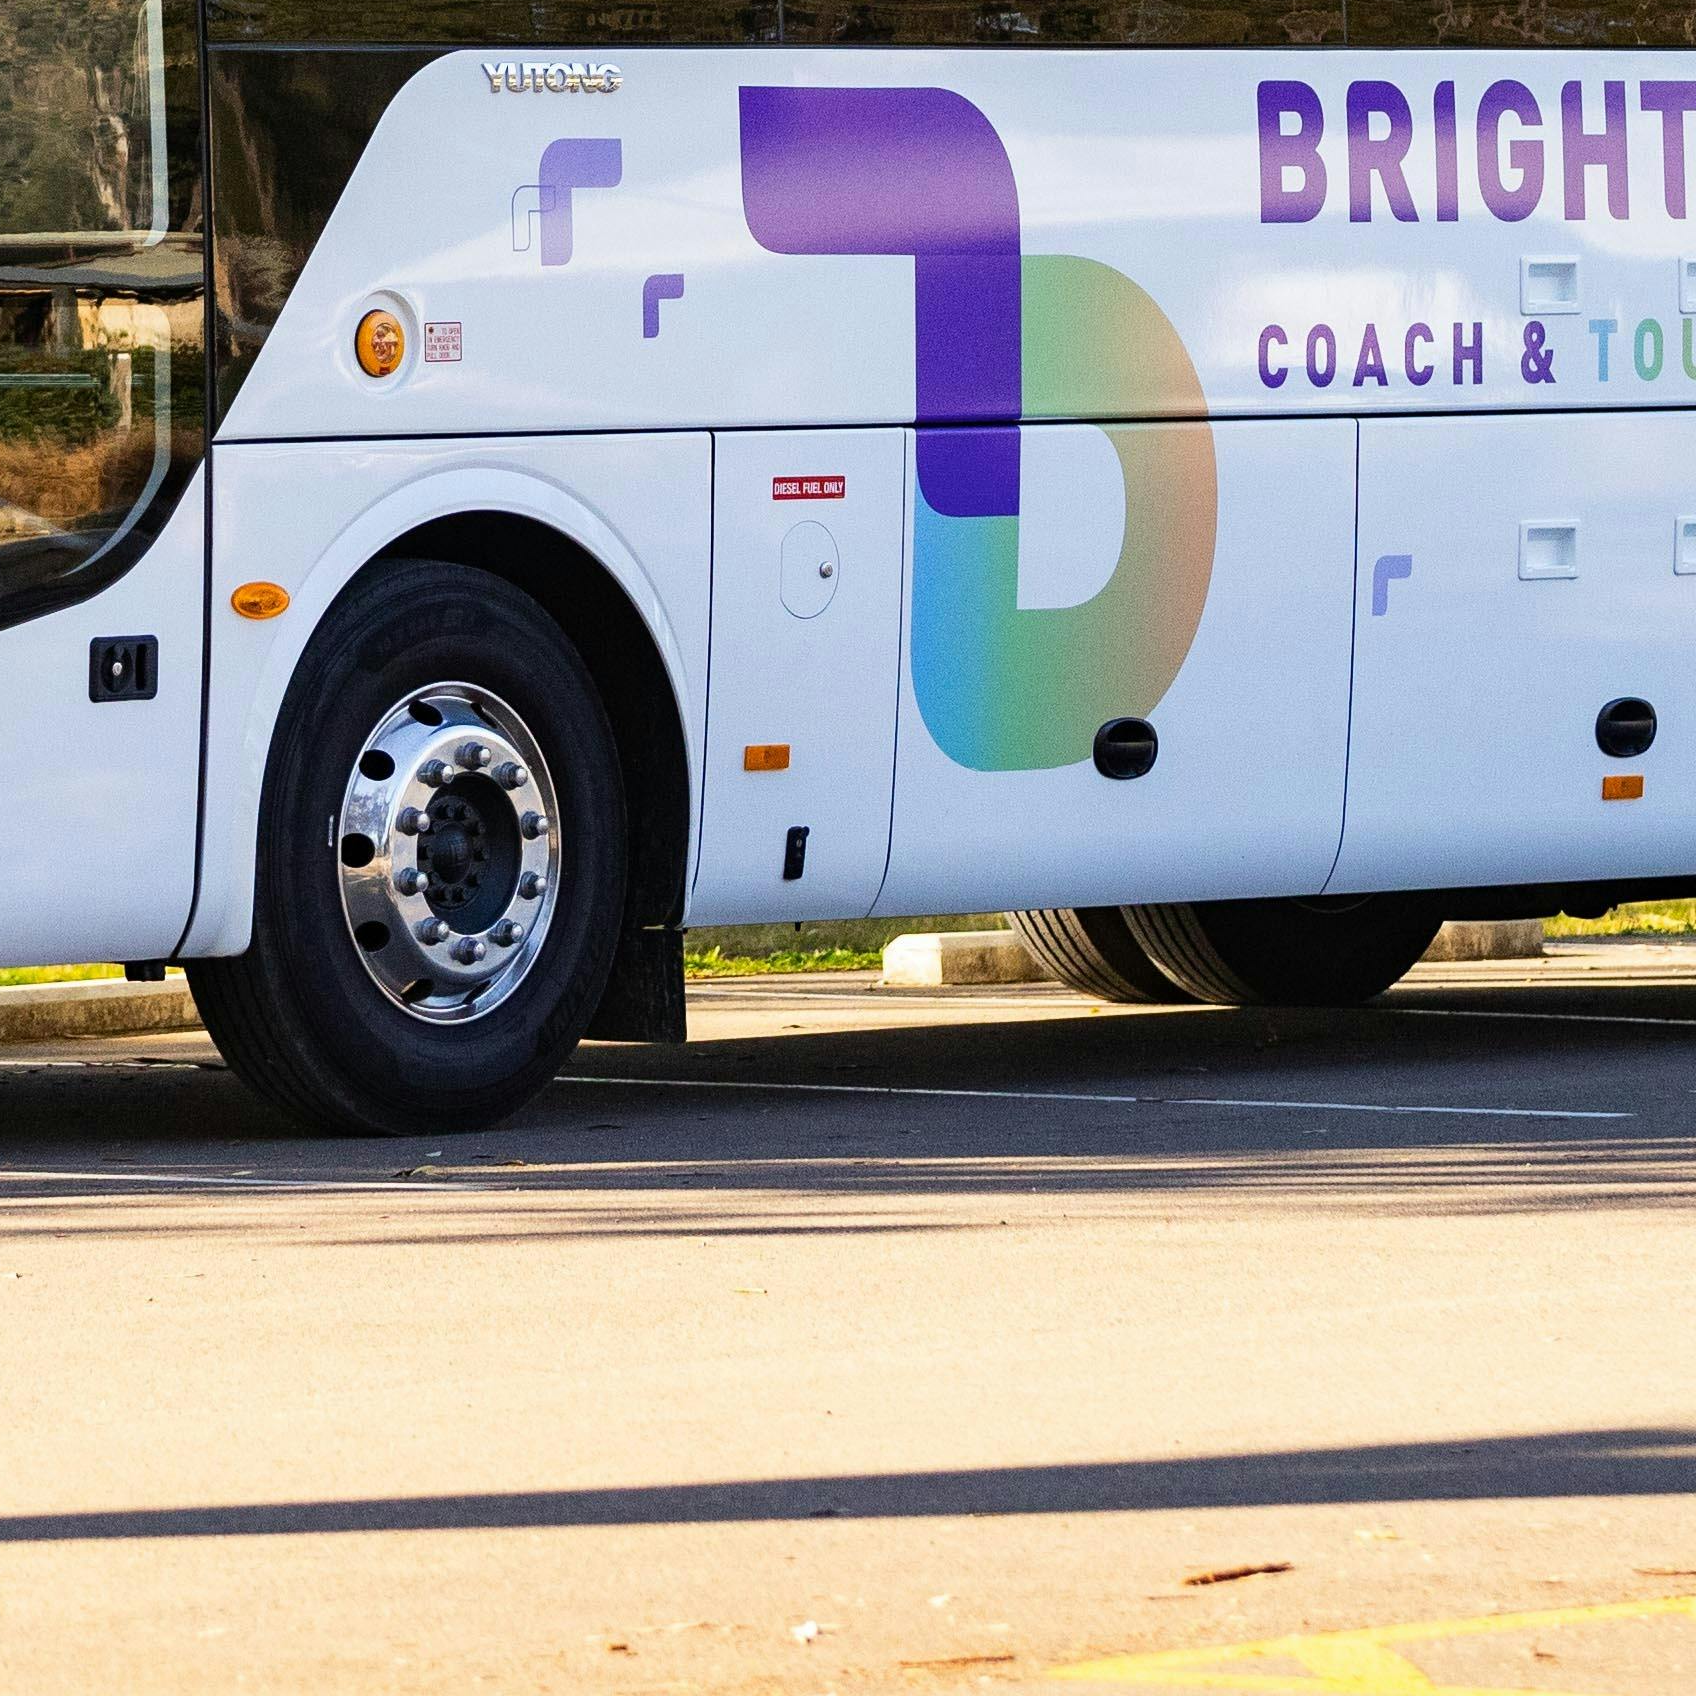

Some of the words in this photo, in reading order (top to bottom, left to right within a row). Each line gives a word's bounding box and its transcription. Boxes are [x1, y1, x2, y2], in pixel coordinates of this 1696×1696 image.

[481, 62, 624, 94] YUTONG
[1257, 321, 1484, 389] COACH
[1520, 319, 1557, 385] &
[774, 482, 801, 495] DIESEL
[802, 482, 823, 495] FUEL
[823, 481, 844, 494] ONLY
